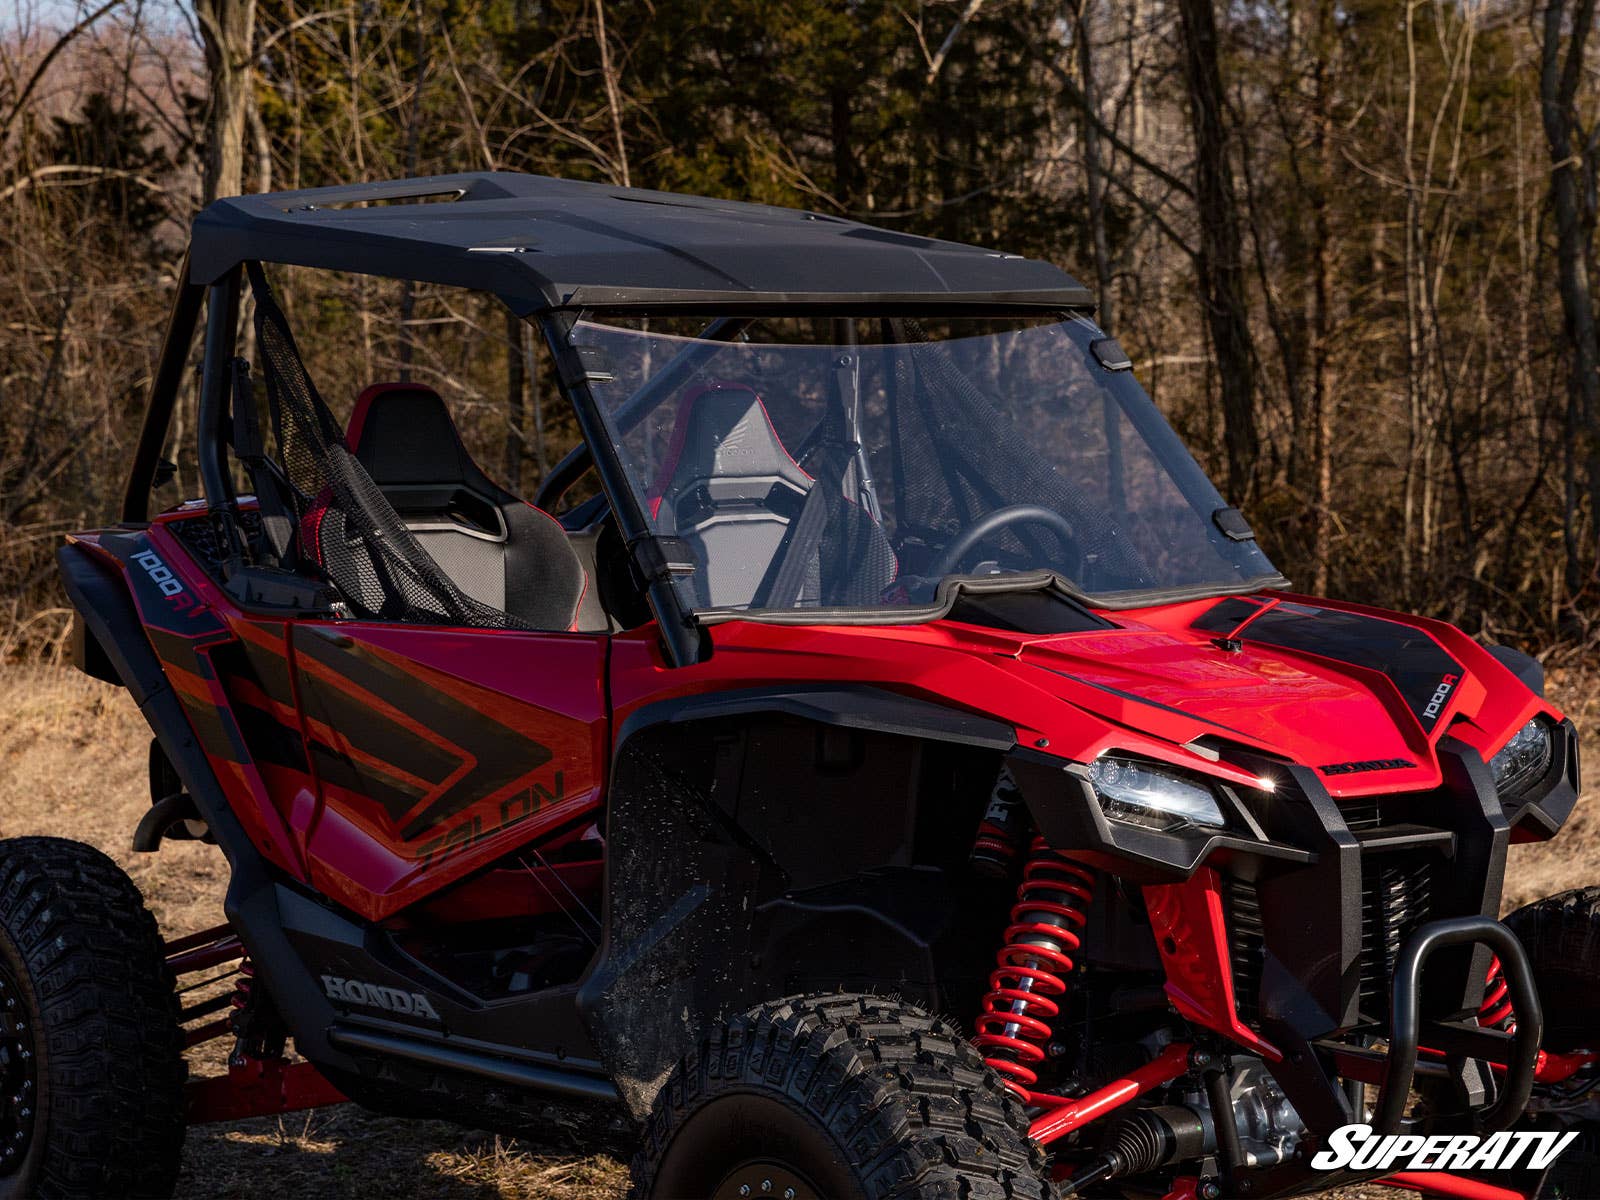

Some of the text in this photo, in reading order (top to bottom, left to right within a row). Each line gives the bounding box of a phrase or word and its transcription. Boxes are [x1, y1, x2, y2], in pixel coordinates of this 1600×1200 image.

[130, 548, 195, 612] 1000R
[1422, 673, 1459, 719] 1000R
[1317, 758, 1418, 776] HONDA
[416, 769, 564, 873] TALON
[320, 975, 440, 1019] HONDA
